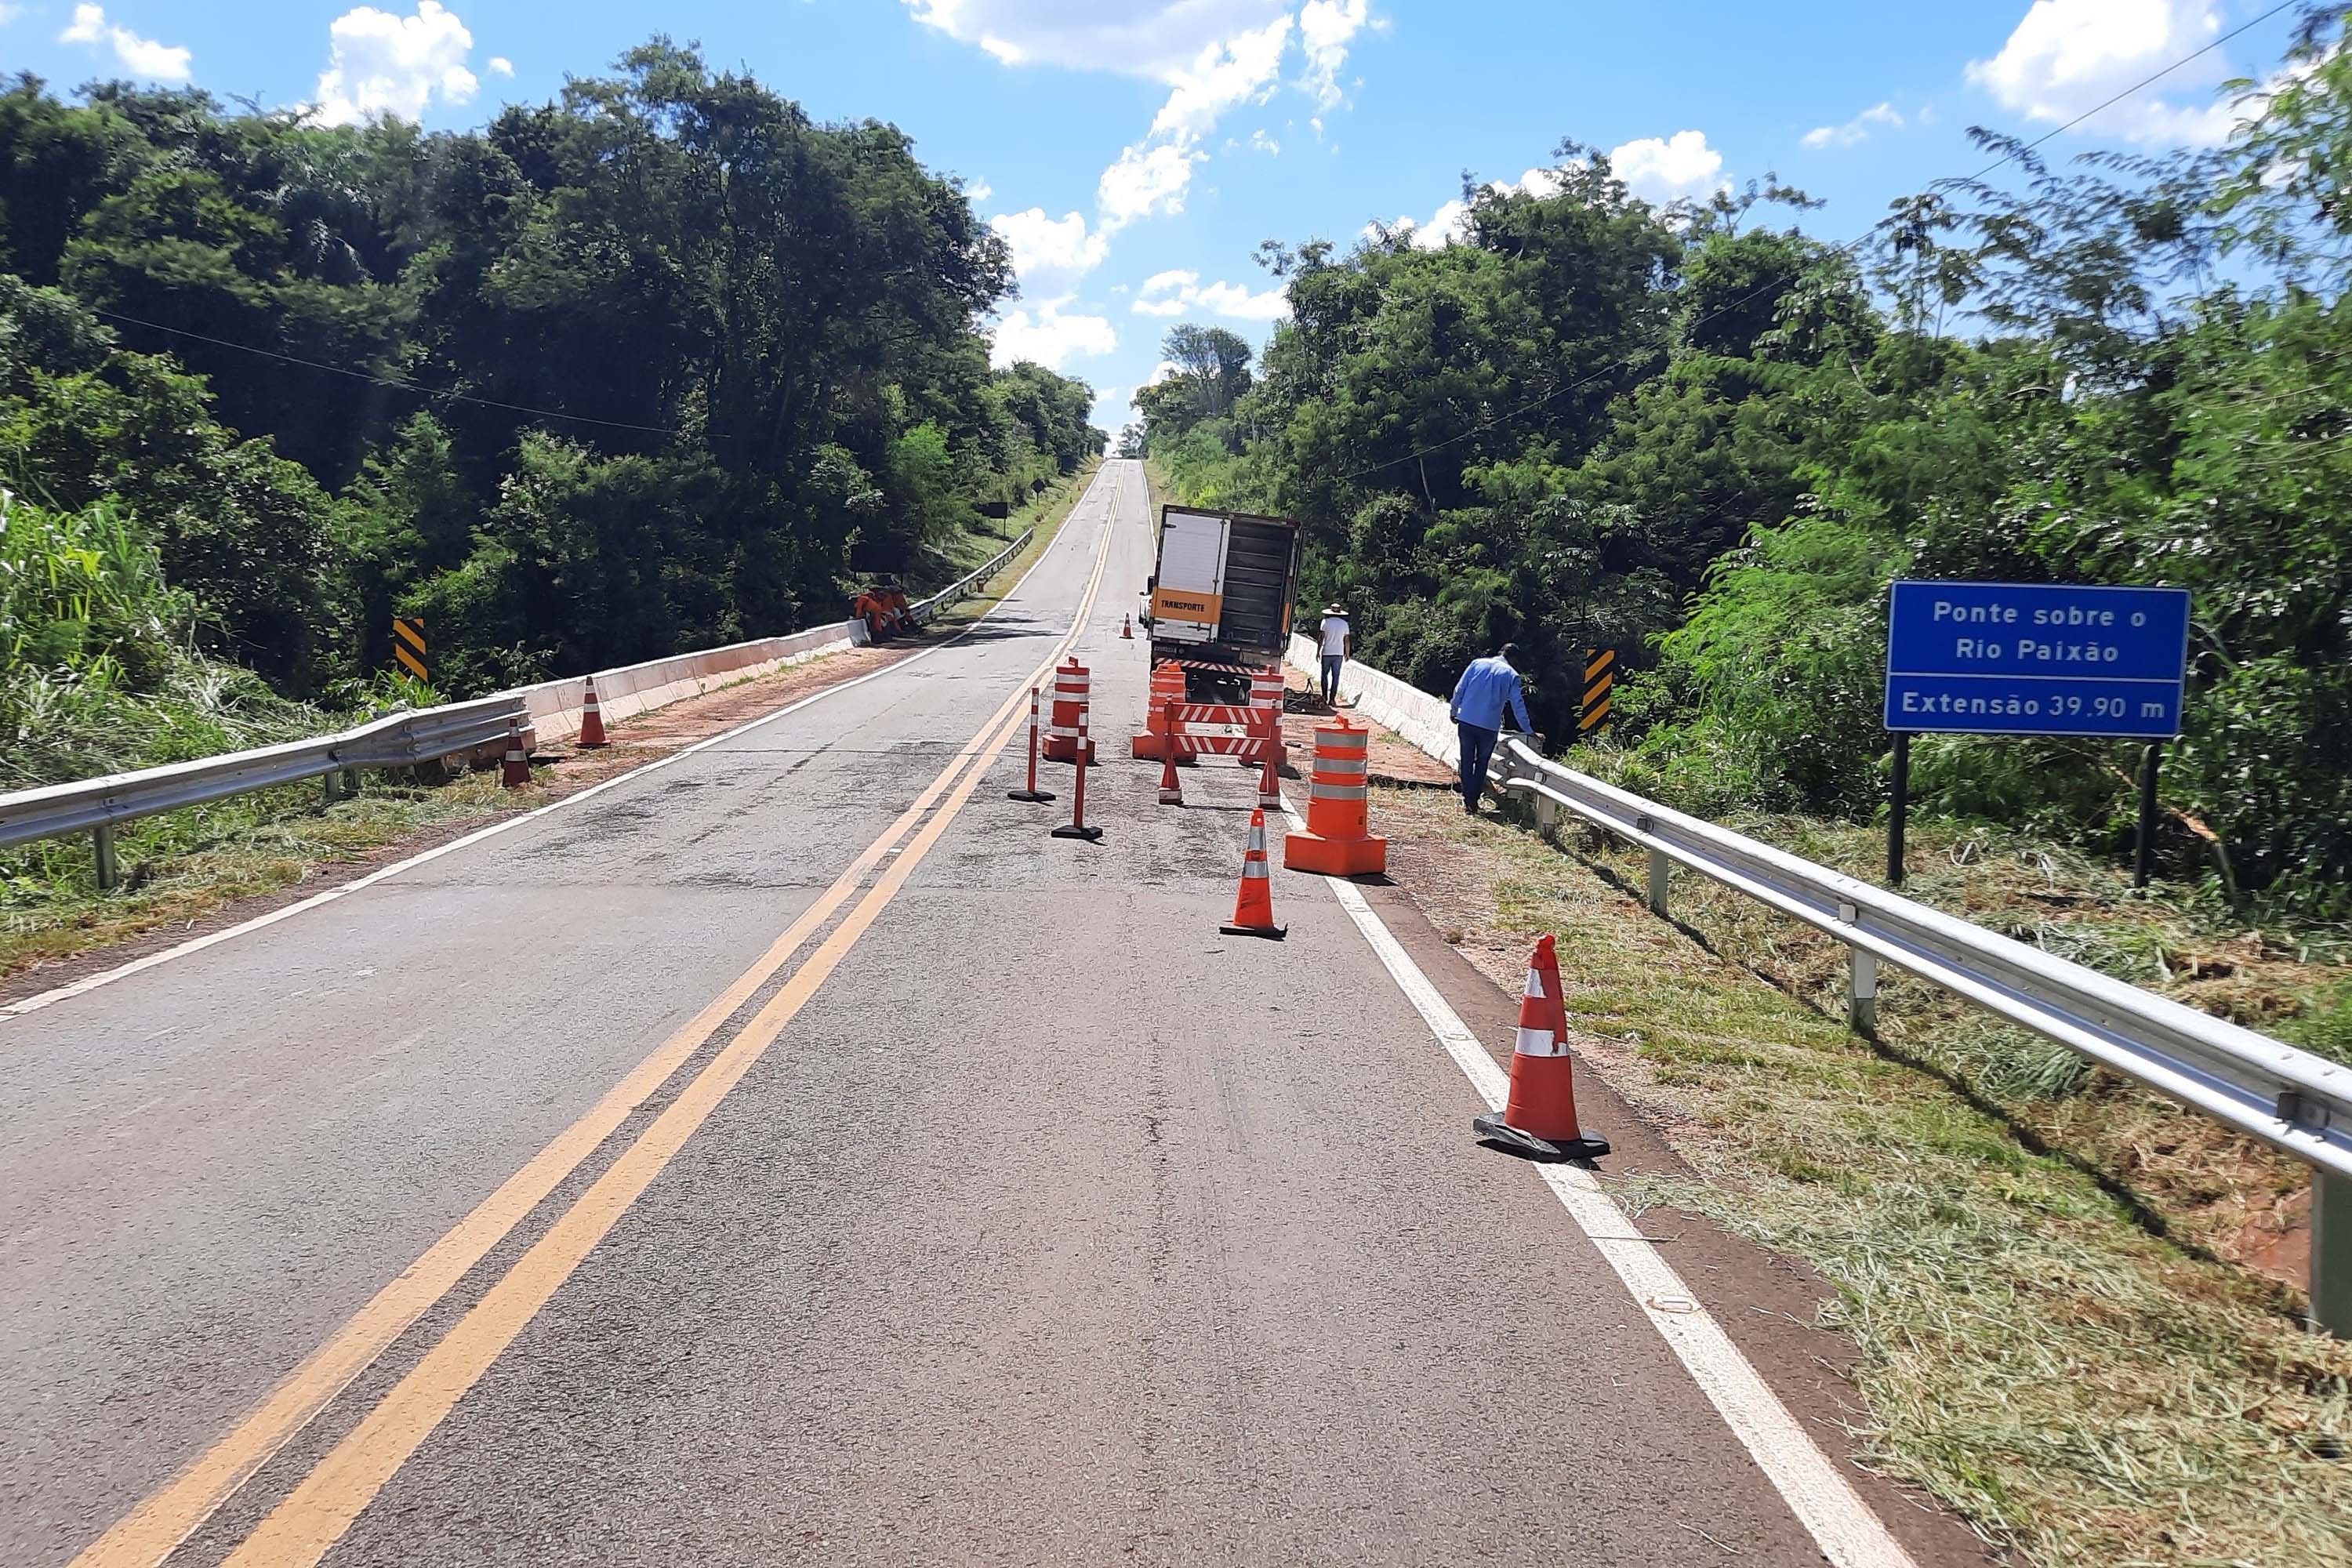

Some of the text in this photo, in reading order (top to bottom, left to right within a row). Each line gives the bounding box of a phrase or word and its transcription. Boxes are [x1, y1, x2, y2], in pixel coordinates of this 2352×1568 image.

[1161, 601, 1205, 612] TRANSPORTE
[1933, 601, 2147, 627] Ponte sobre o
[1956, 638, 2119, 662] Rio Paixão
[1902, 691, 2038, 716] Extensão
[2140, 702, 2165, 718] m
